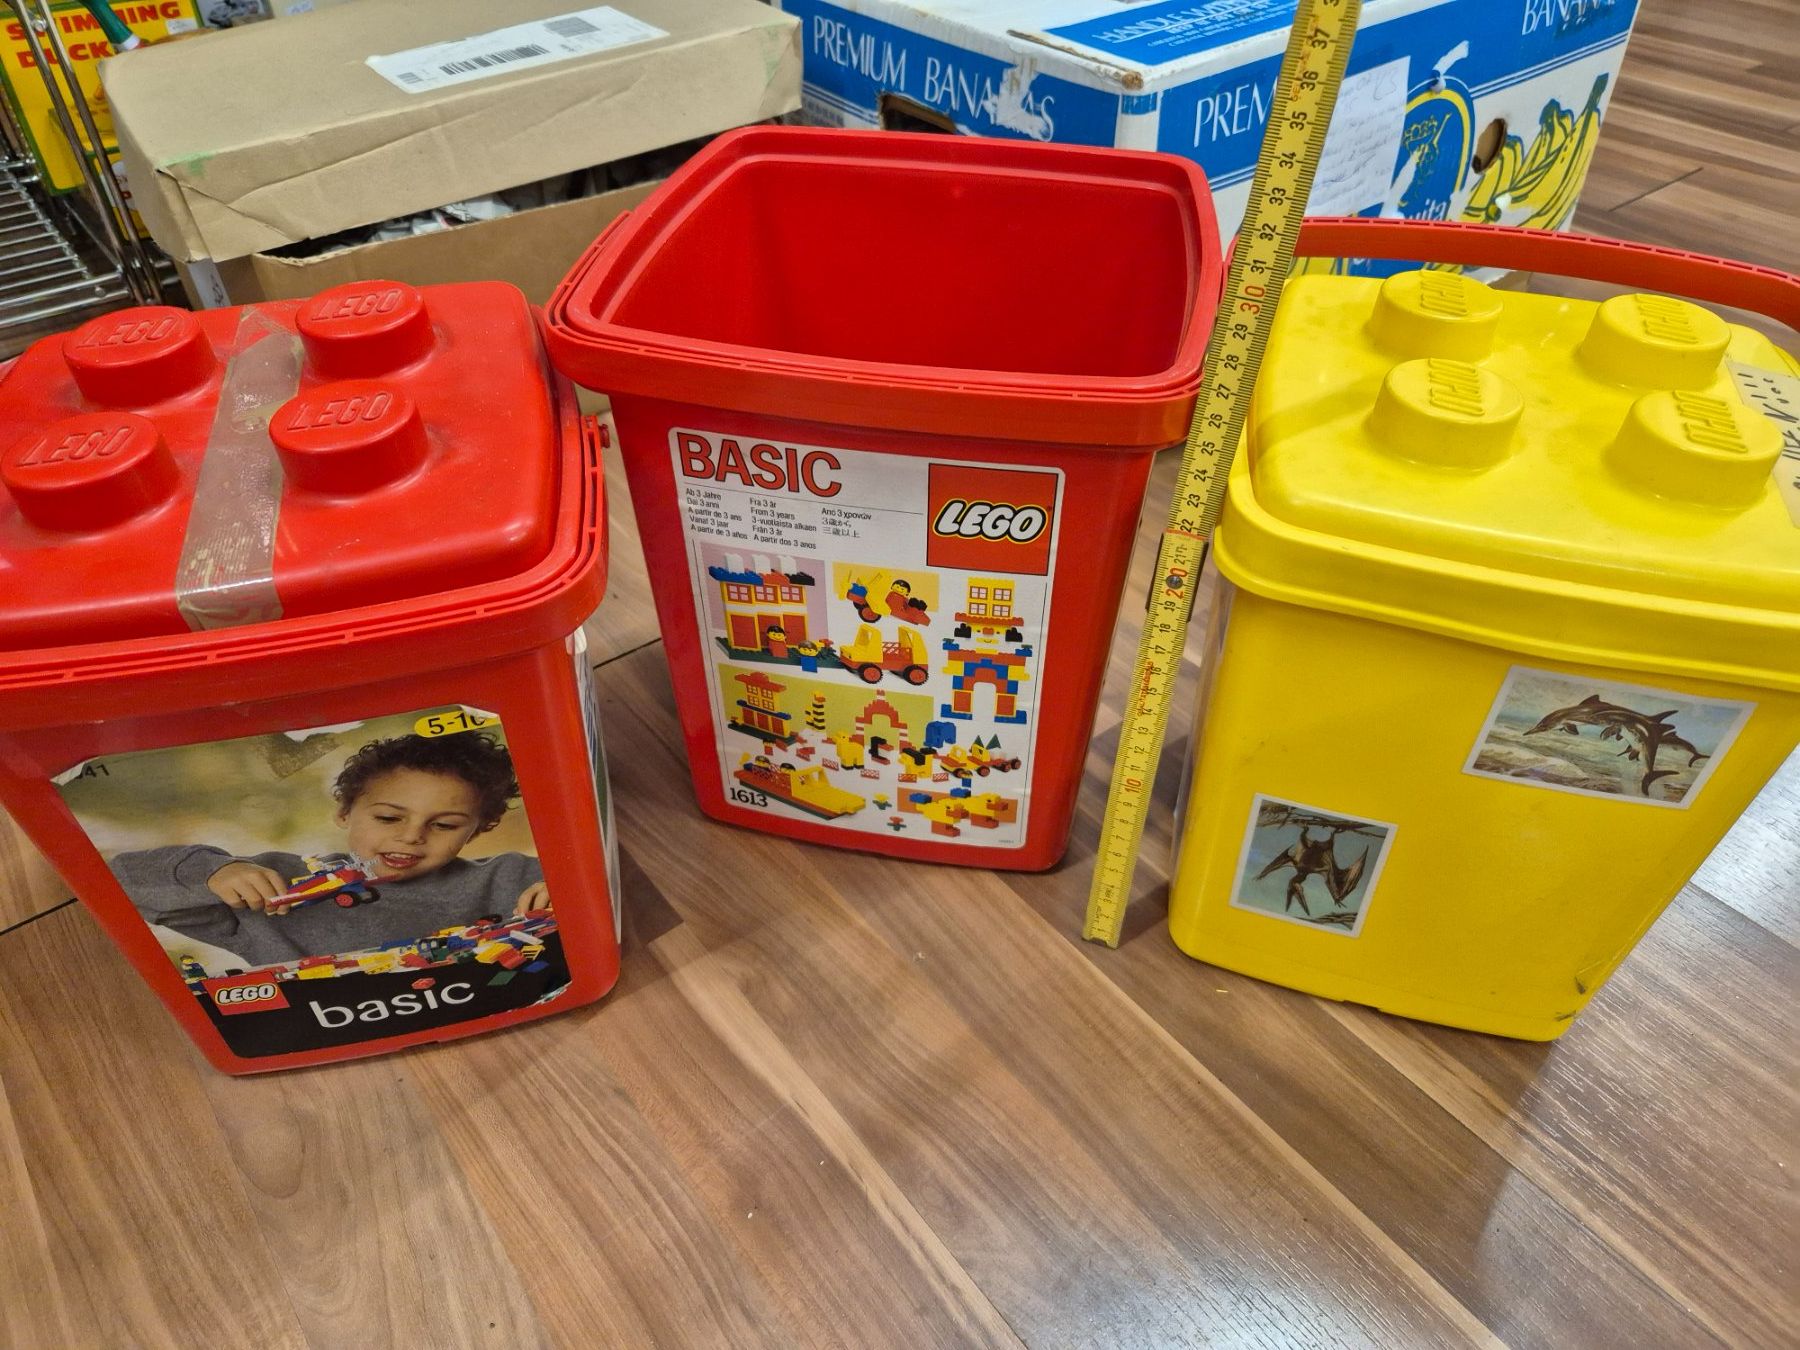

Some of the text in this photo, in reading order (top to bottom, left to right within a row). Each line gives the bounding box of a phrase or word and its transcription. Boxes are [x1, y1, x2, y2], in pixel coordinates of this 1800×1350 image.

[6, 1, 181, 40] SIMING
[1311, 28, 1330, 50] 37
[813, 15, 1055, 143] PREMIUM BANAAS
[1300, 70, 1319, 91] 36
[1193, 76, 1279, 148] PREM
[1289, 111, 1307, 131] 35
[1279, 151, 1297, 170] 34
[1269, 187, 1286, 206] 33
[1260, 223, 1277, 241] 32
[1250, 259, 1267, 275] 31
[311, 288, 403, 320] LEGO
[1240, 285, 1265, 316] 30
[76, 316, 178, 349] LEGO
[1232, 323, 1249, 341] 29
[1224, 354, 1240, 371] 28
[1216, 383, 1231, 400] 27
[288, 391, 394, 431] LEGO
[1208, 413, 1223, 429] 26
[17, 426, 136, 468] LEGO
[1201, 441, 1215, 456] 25
[676, 431, 842, 498] BASIC
[1193, 469, 1207, 482] 24
[700, 499, 705, 507] 3
[763, 499, 768, 507] 3
[1186, 493, 1200, 508] 23
[751, 507, 795, 520] From 3 years
[837, 509, 843, 517] 3
[933, 499, 1048, 543] LEGO
[710, 518, 716, 526] 3
[1180, 519, 1194, 533] 22
[769, 527, 775, 535] 3
[793, 539, 798, 547] 3
[1165, 567, 1188, 600] 20
[1164, 601, 1176, 612] 19
[1159, 623, 1171, 634] 18
[1154, 645, 1166, 655] 17
[1150, 666, 1162, 676] 16
[1147, 687, 1158, 696] 15
[1138, 726, 1149, 736] 13
[1134, 746, 1145, 755] 12
[1130, 764, 1141, 772] 11
[1125, 778, 1142, 794] 10
[730, 787, 768, 808] 1613
[215, 983, 278, 1005] LEGO
[308, 977, 475, 1030] basic
